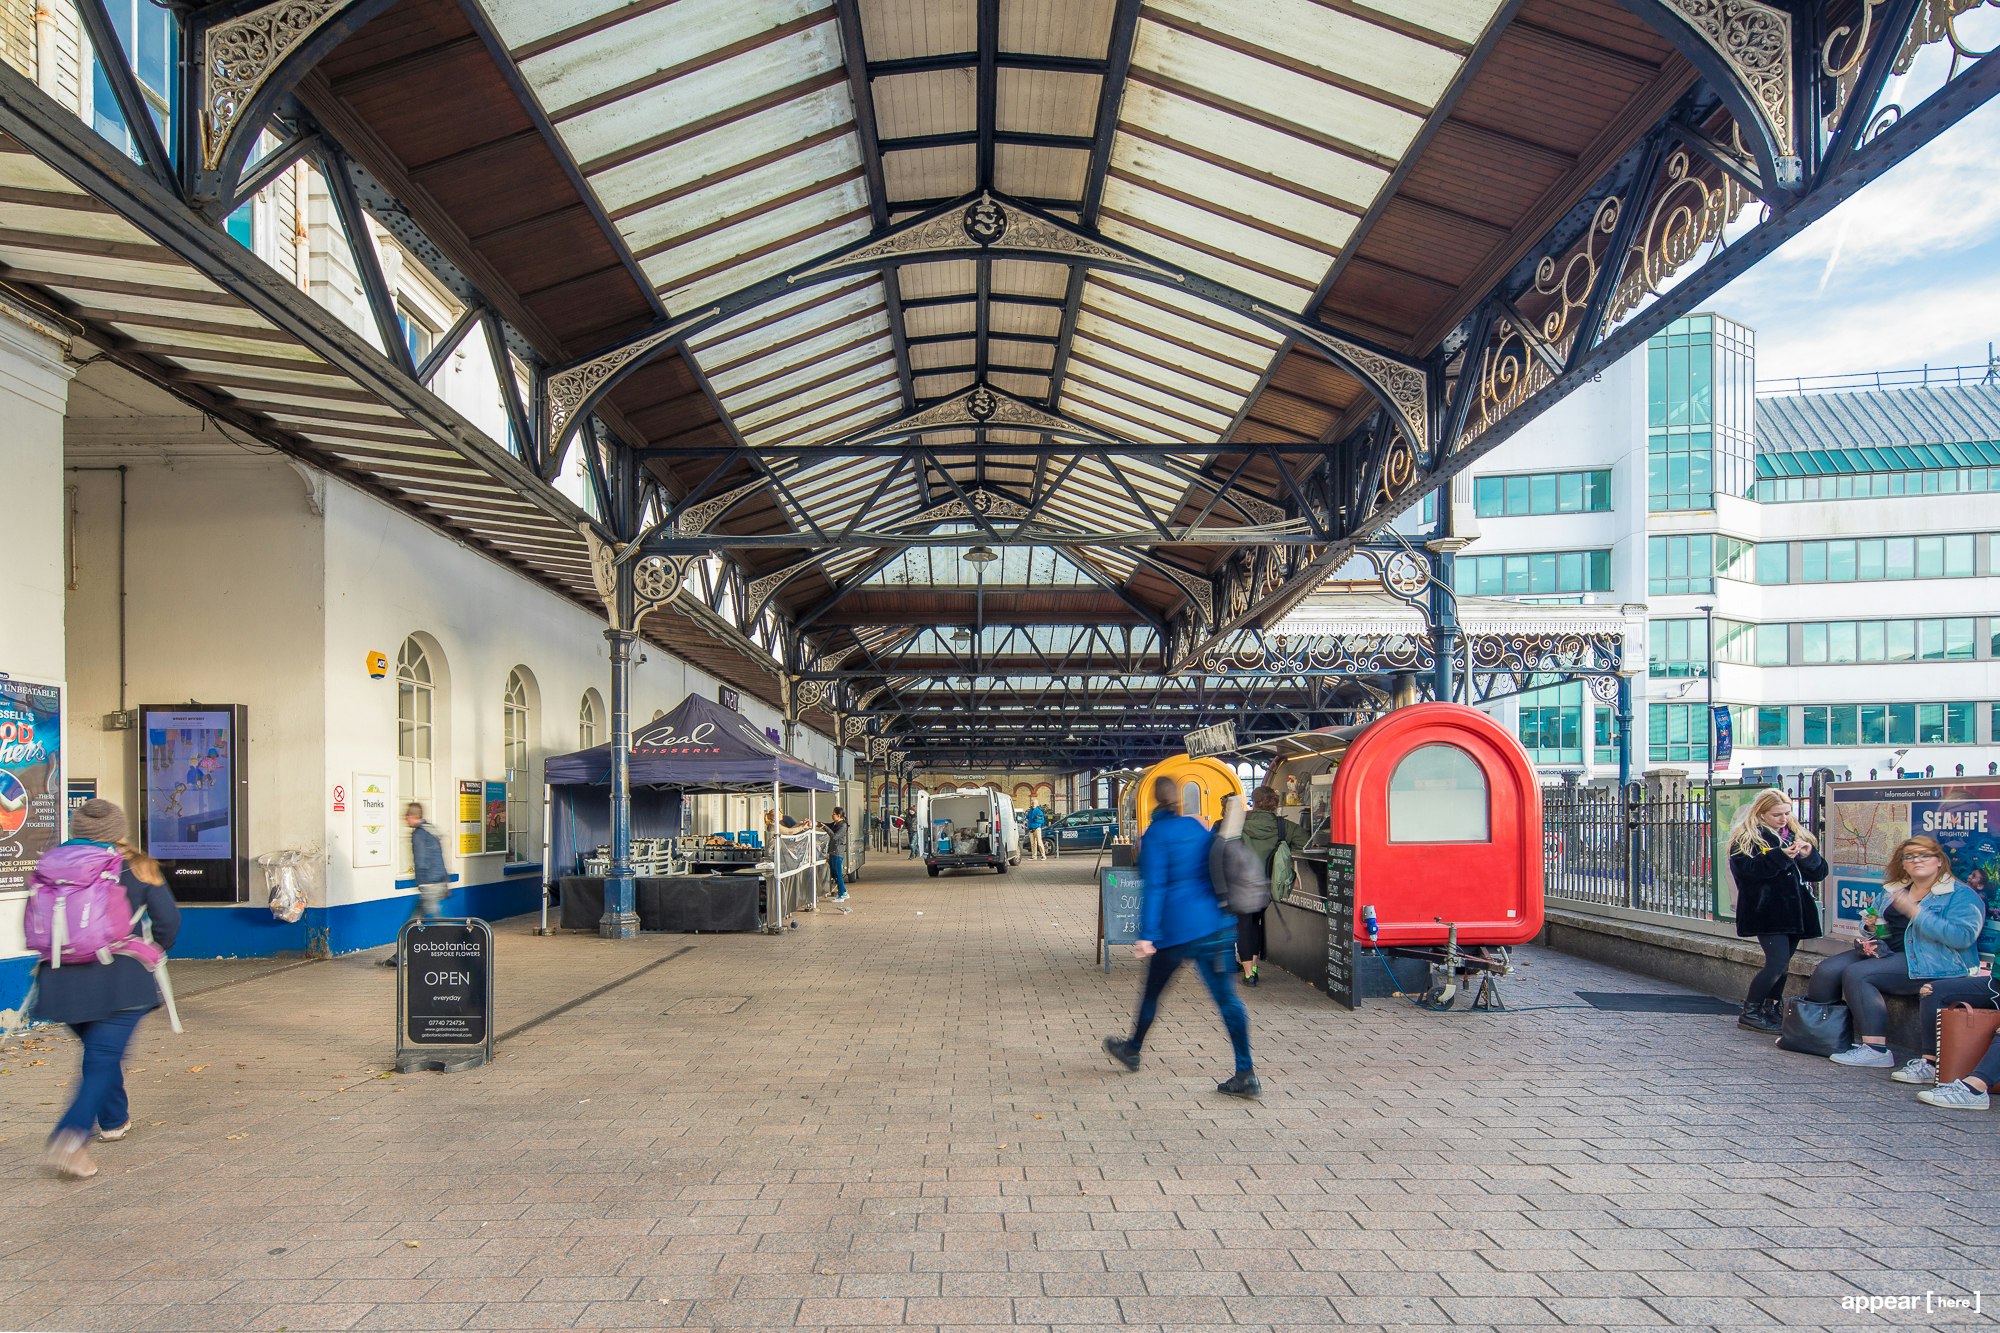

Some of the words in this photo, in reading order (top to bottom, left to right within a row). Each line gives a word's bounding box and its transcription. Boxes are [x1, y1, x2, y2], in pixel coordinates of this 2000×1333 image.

[636, 722, 715, 747] Real
[1884, 790, 1916, 798] Information
[1916, 789, 1931, 797] Point
[363, 800, 384, 808] Thanks
[1922, 810, 1953, 832] SEA
[1841, 888, 1868, 909] SEA
[413, 941, 480, 953] go.botanica
[424, 971, 470, 986] OPEN
[433, 994, 461, 1002] everyday
